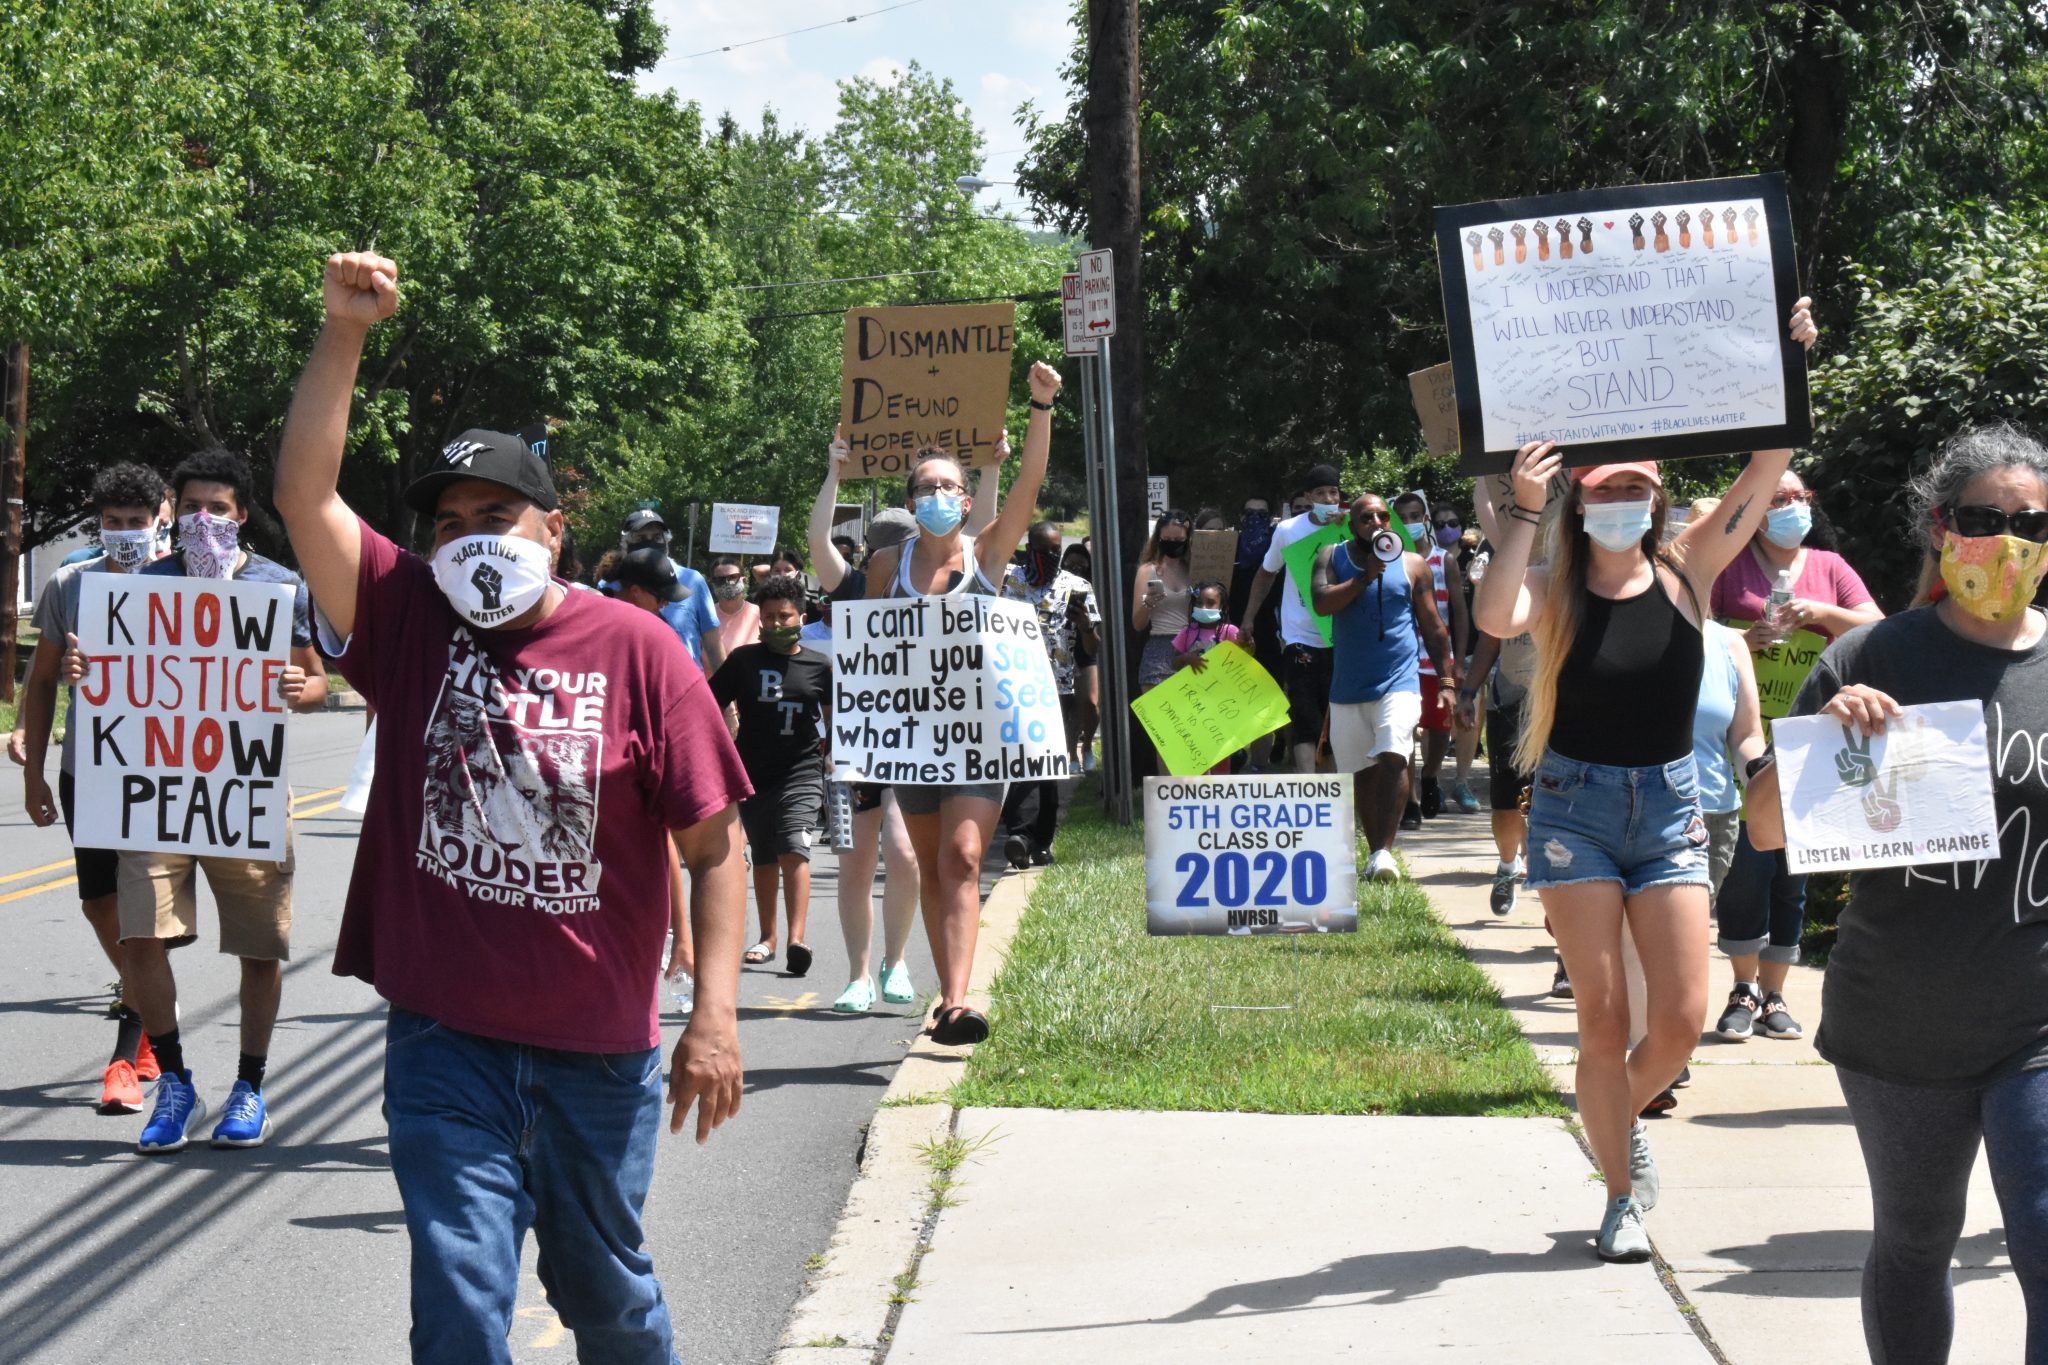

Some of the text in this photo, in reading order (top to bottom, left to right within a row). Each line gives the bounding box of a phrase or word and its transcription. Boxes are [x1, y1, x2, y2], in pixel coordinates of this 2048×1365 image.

[1090, 257, 1103, 274] NO
[1064, 278, 1075, 299] NO
[1084, 277, 1110, 296] PARKING
[1499, 285, 1515, 308] I
[1535, 270, 1651, 305] UNDERSTAND
[1661, 264, 1709, 289] THAT
[1724, 261, 1738, 284] I
[1492, 315, 1549, 342] WILL
[1554, 309, 1611, 336] NEVER
[1622, 299, 1736, 330] UNDERSTAND
[858, 316, 1013, 361] DISMANTLE
[1575, 338, 1625, 367] BUT
[1644, 334, 1664, 361] I
[852, 377, 959, 425] DEFUND
[1567, 366, 1675, 411] STAND
[850, 428, 993, 450] HOPEWELL
[862, 448, 973, 475] POLE
[1147, 491, 1162, 499] MIT
[1148, 482, 1166, 490] EED
[1151, 502, 1164, 519] 5
[488, 541, 520, 562] LIVES
[107, 591, 279, 652] KNOW
[469, 604, 515, 623] MATTER
[941, 597, 1039, 640] believe
[836, 640, 917, 676] what
[930, 644, 984, 685] you
[1784, 647, 1818, 667] NOT
[81, 654, 287, 713] JUSTICE
[515, 668, 608, 696] YOUR
[757, 669, 784, 702] B
[1221, 650, 1263, 706] WHEN
[836, 682, 967, 714] because
[1178, 683, 1206, 714] FROM
[1217, 698, 1241, 720] GO
[777, 701, 804, 736] T
[836, 706, 1046, 757] what you do
[92, 715, 285, 777] KNOW
[965, 744, 1068, 781] Baldwin
[1157, 781, 1342, 801] CONGRATULATIONS
[121, 774, 274, 849] PEACE
[1167, 803, 1333, 830] 5TH GRADE
[1197, 831, 1304, 850] CLASS OF
[1798, 832, 1991, 864] LISTEN LEARN CHANGE
[415, 852, 601, 915] THAN YOUR MOUTH
[1175, 850, 1328, 908] 2020
[1227, 909, 1280, 926] HVRSD
